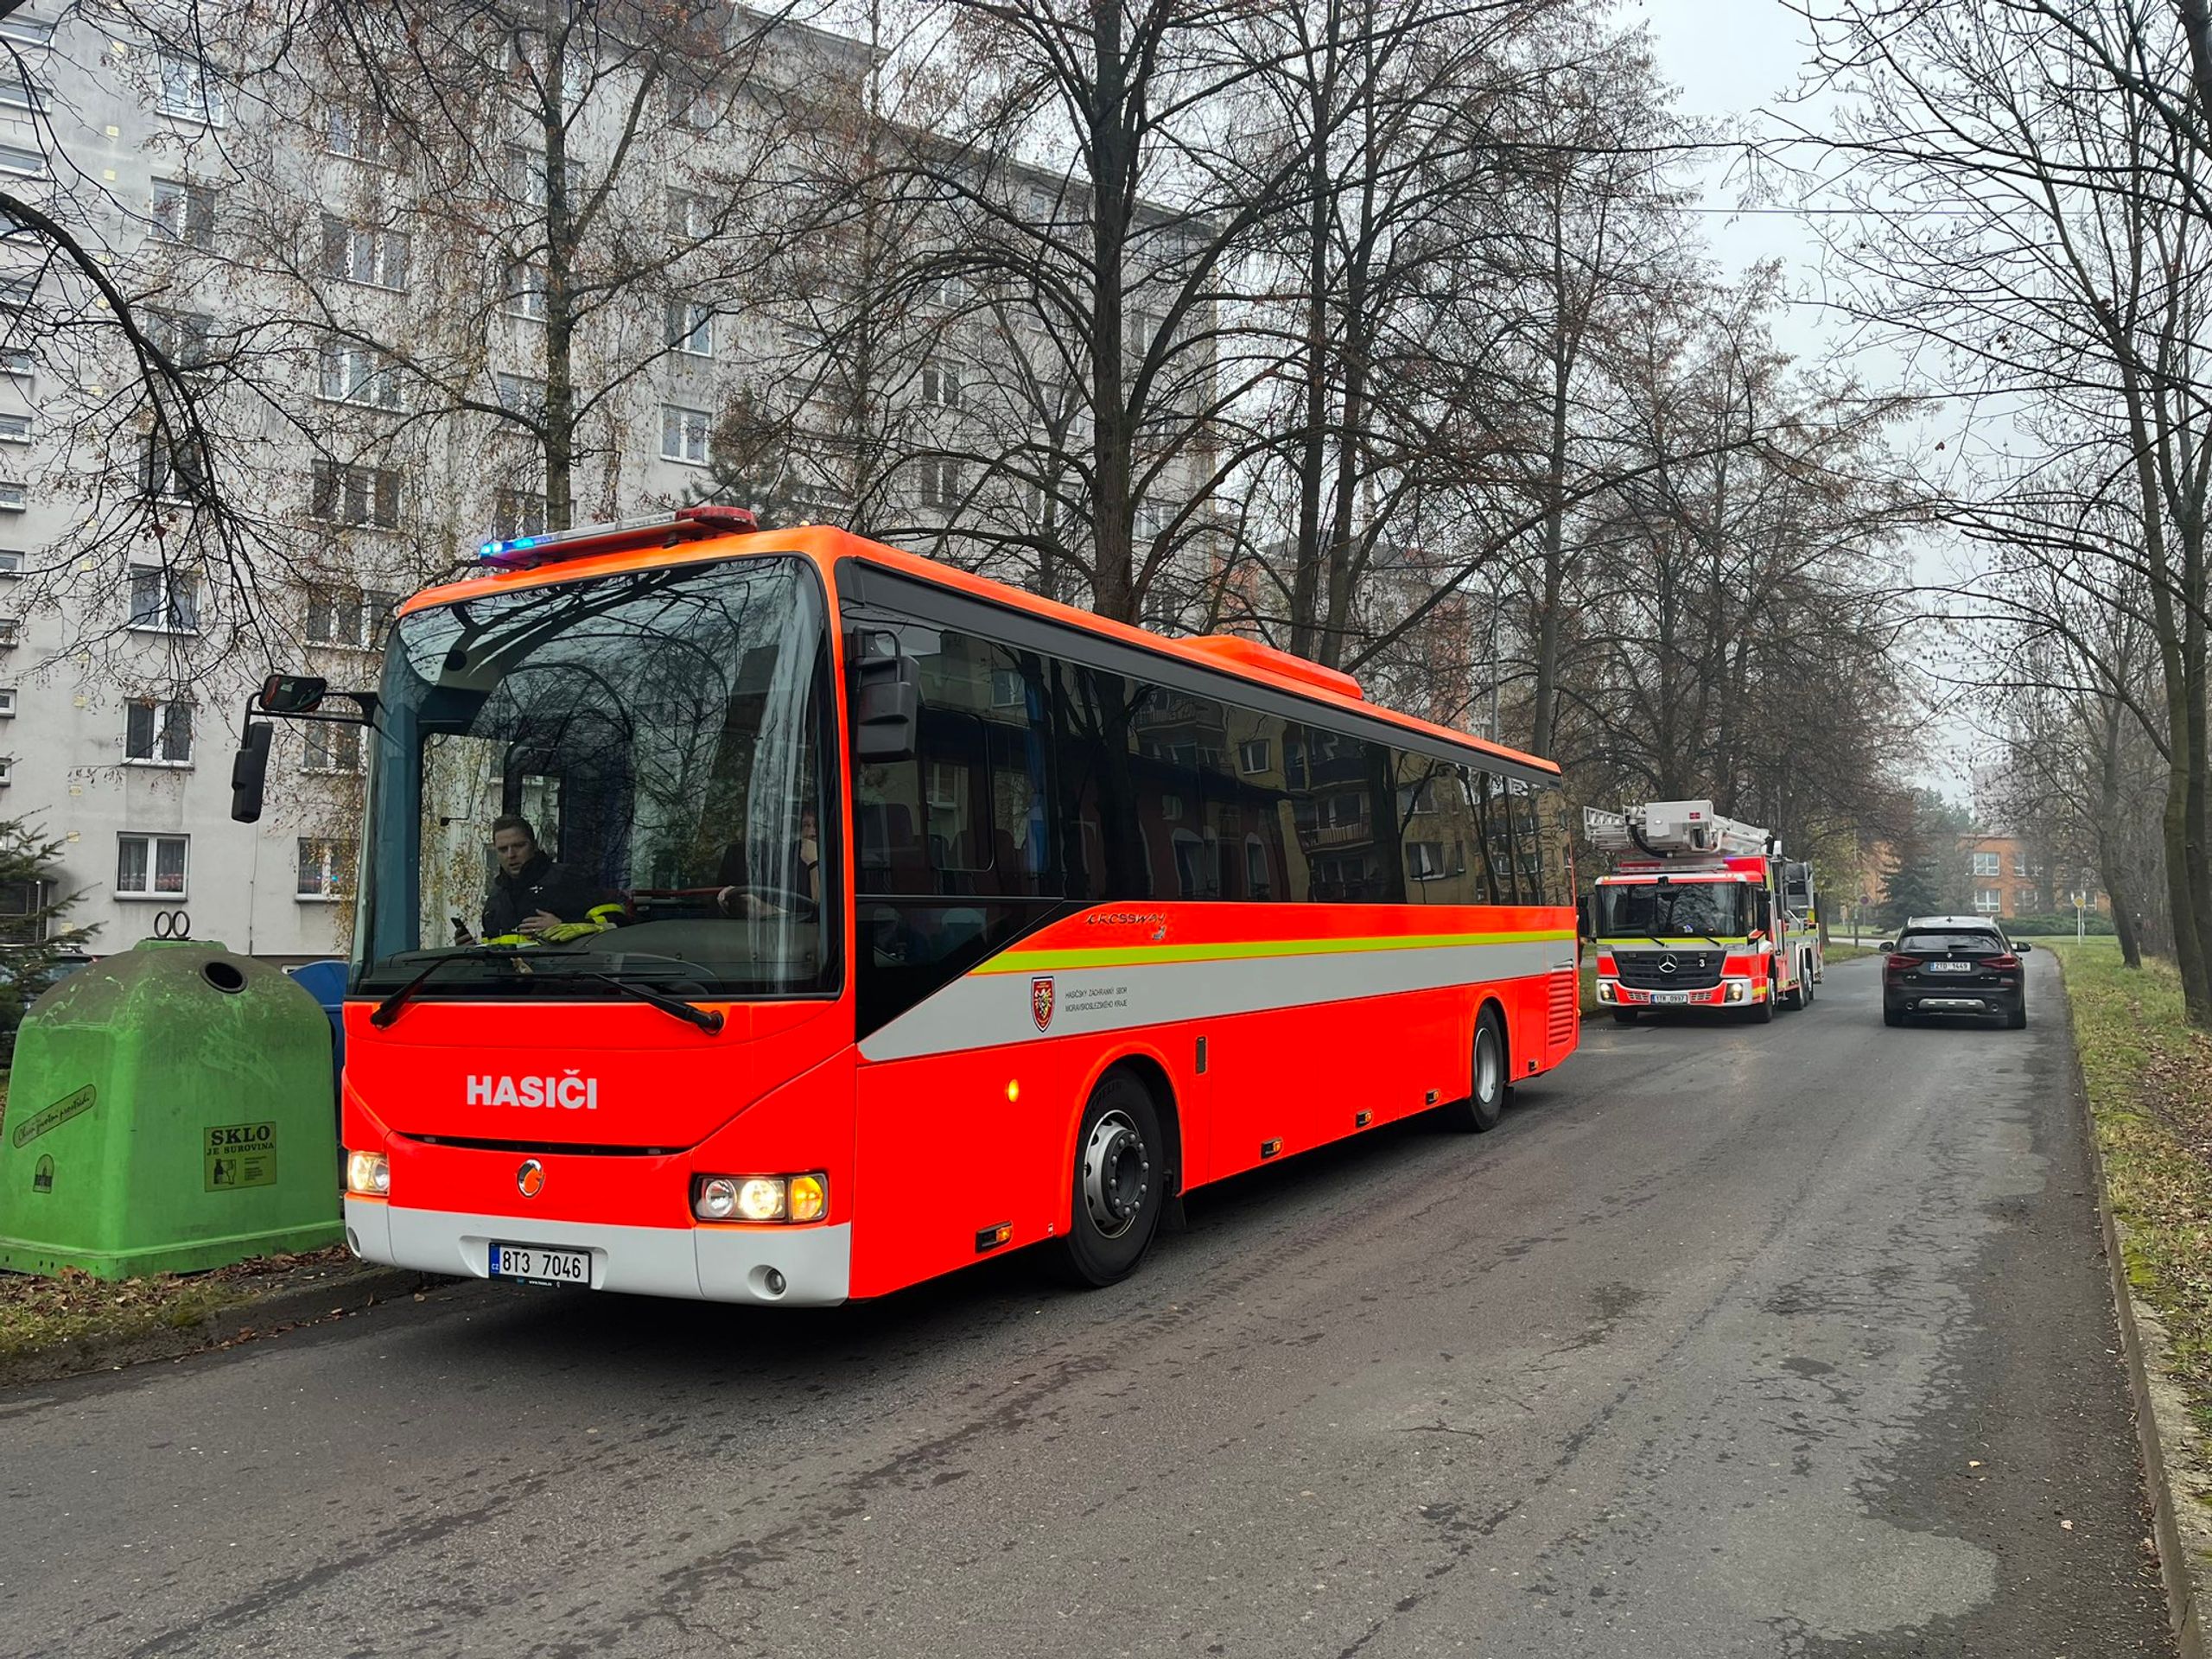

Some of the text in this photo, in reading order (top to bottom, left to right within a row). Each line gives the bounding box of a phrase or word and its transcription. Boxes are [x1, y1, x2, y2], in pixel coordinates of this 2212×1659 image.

[1699, 958, 1706, 968] 3
[467, 1069, 598, 1109] HASIČI
[211, 1125, 270, 1146] SKLO
[207, 1142, 275, 1156] JE SUROVINA
[491, 1262, 499, 1271] CZ
[503, 1250, 582, 1279] 8T3 7046
